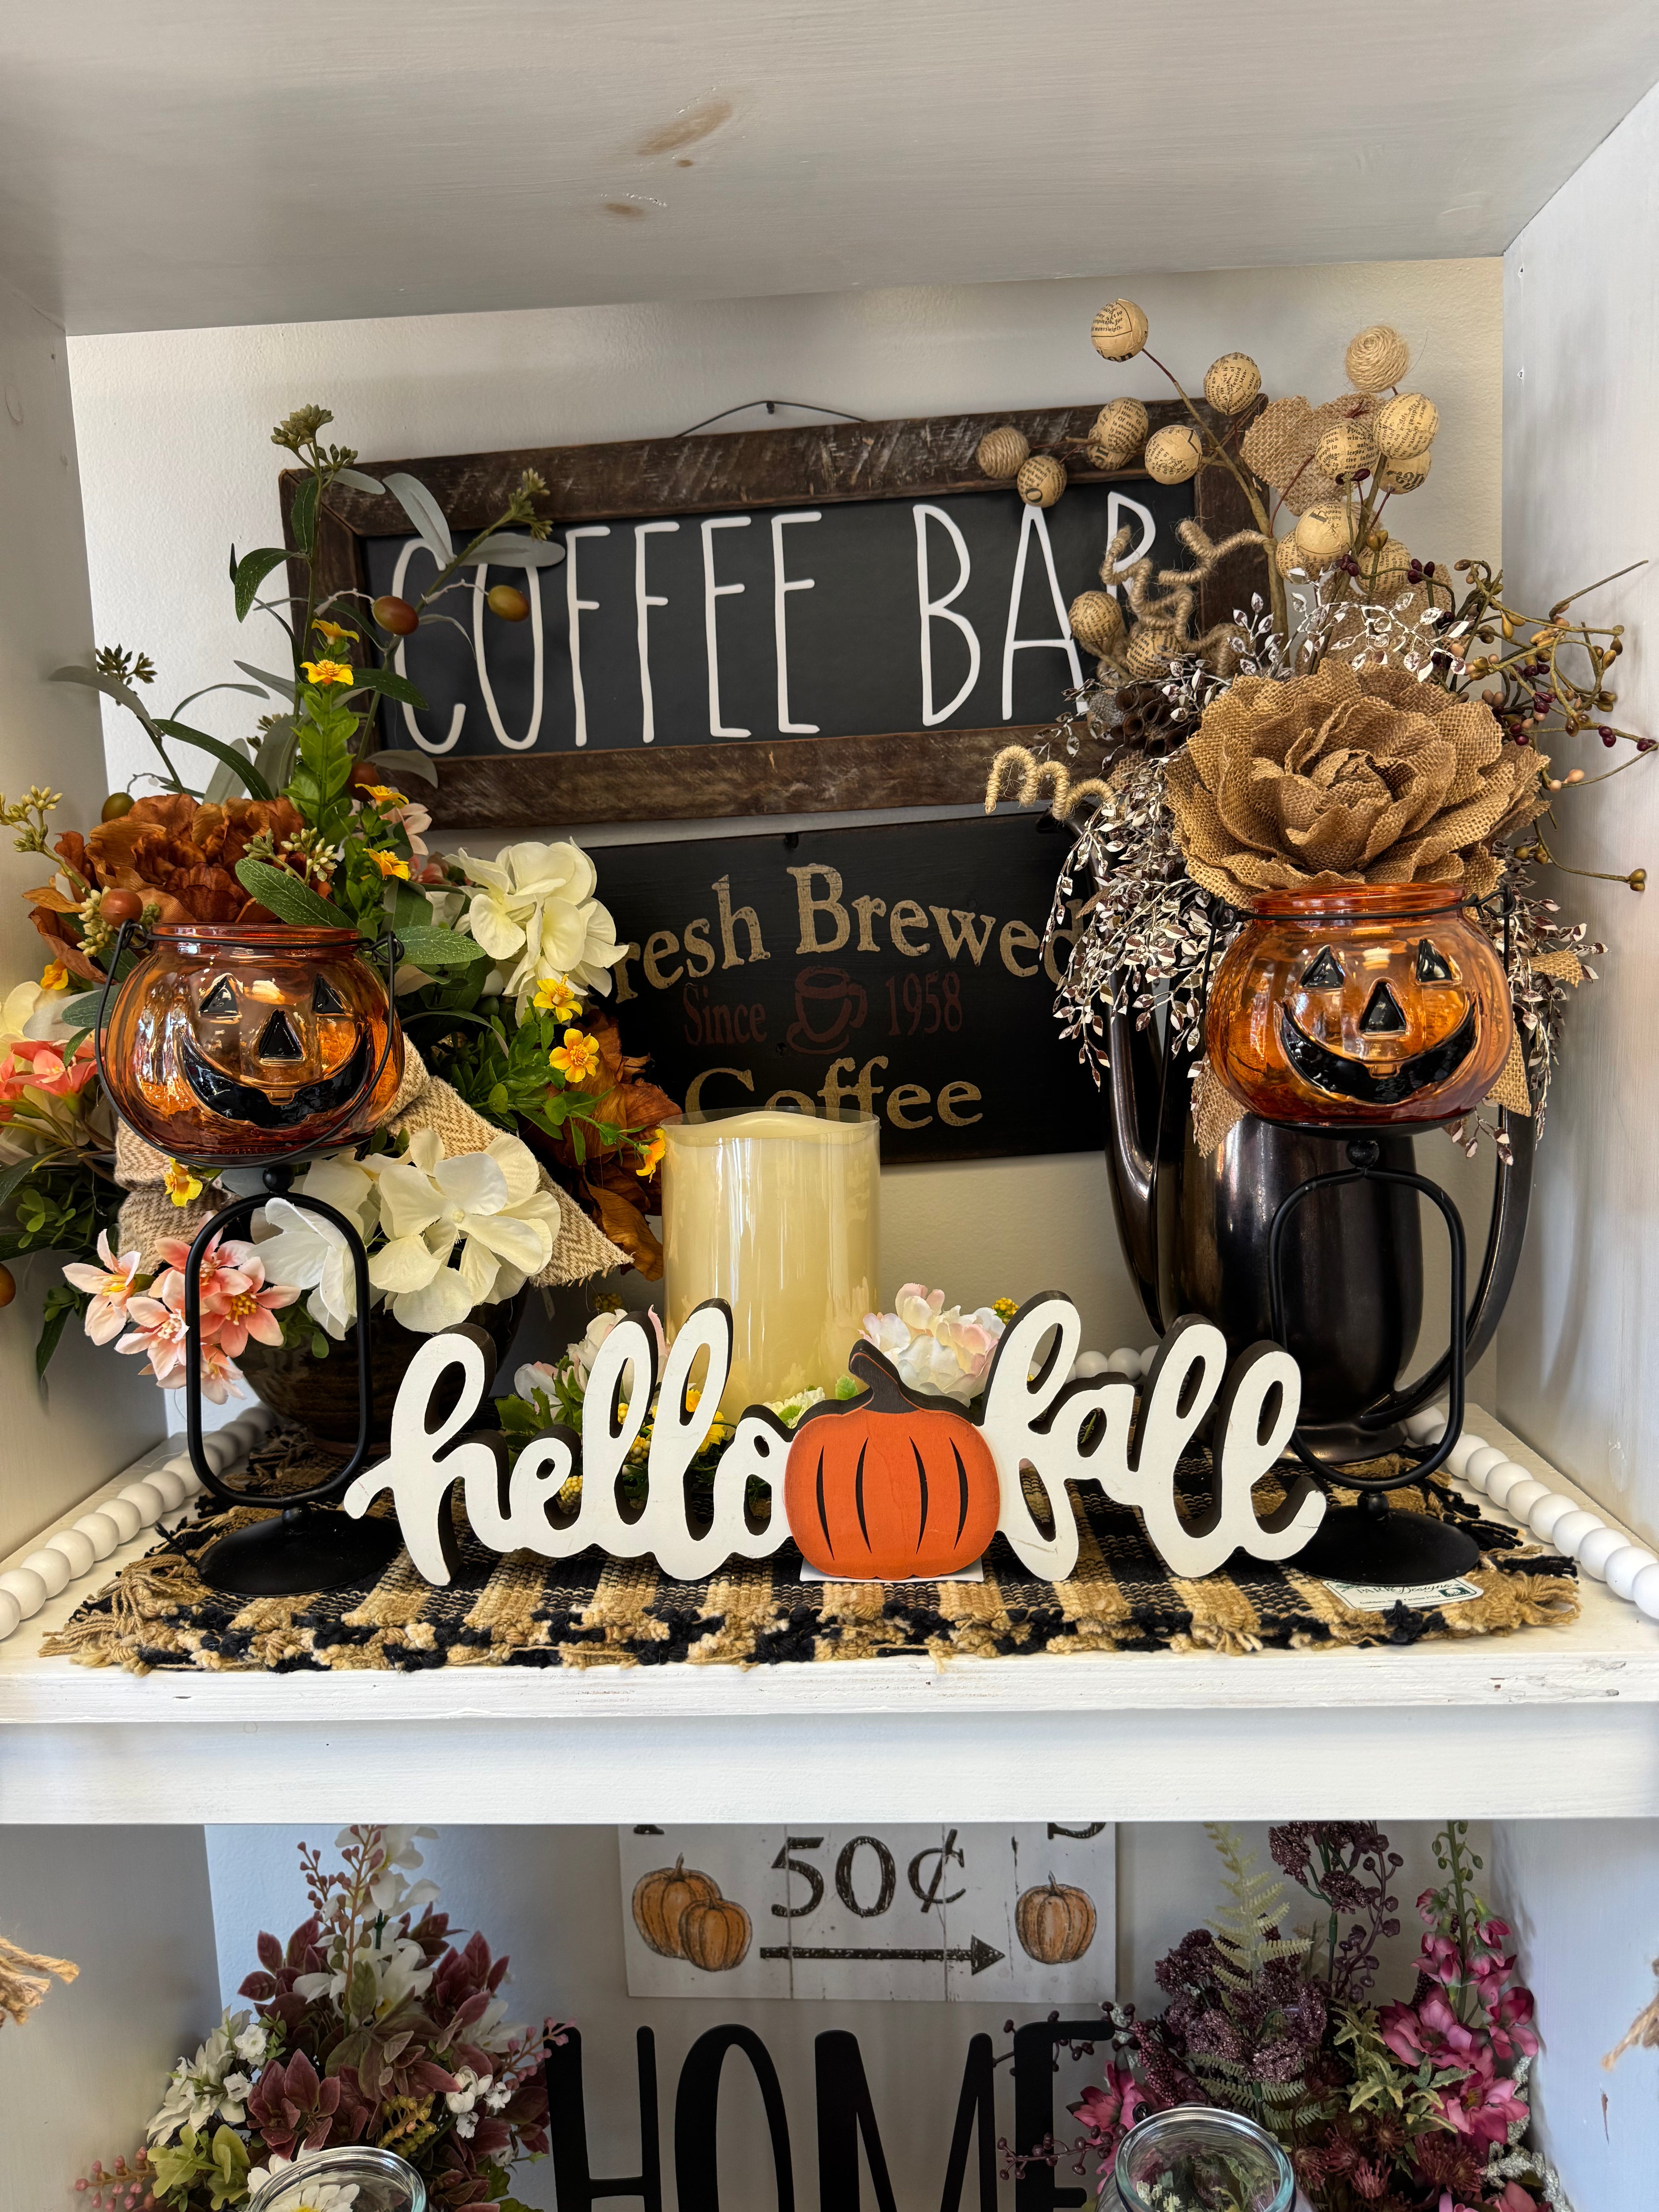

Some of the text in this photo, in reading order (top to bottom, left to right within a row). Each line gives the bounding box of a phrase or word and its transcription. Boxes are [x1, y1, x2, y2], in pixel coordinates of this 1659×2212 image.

[391, 491, 1156, 753] COFFEE BAR
[615, 864, 1087, 1004] resh Brewed
[683, 971, 963, 1045] Since 1958
[685, 1055, 983, 1129] Coffee
[343, 1291, 1326, 1585] hello fall
[771, 1829, 966, 1918] 50¢
[543, 2020, 1115, 2212] HOME
